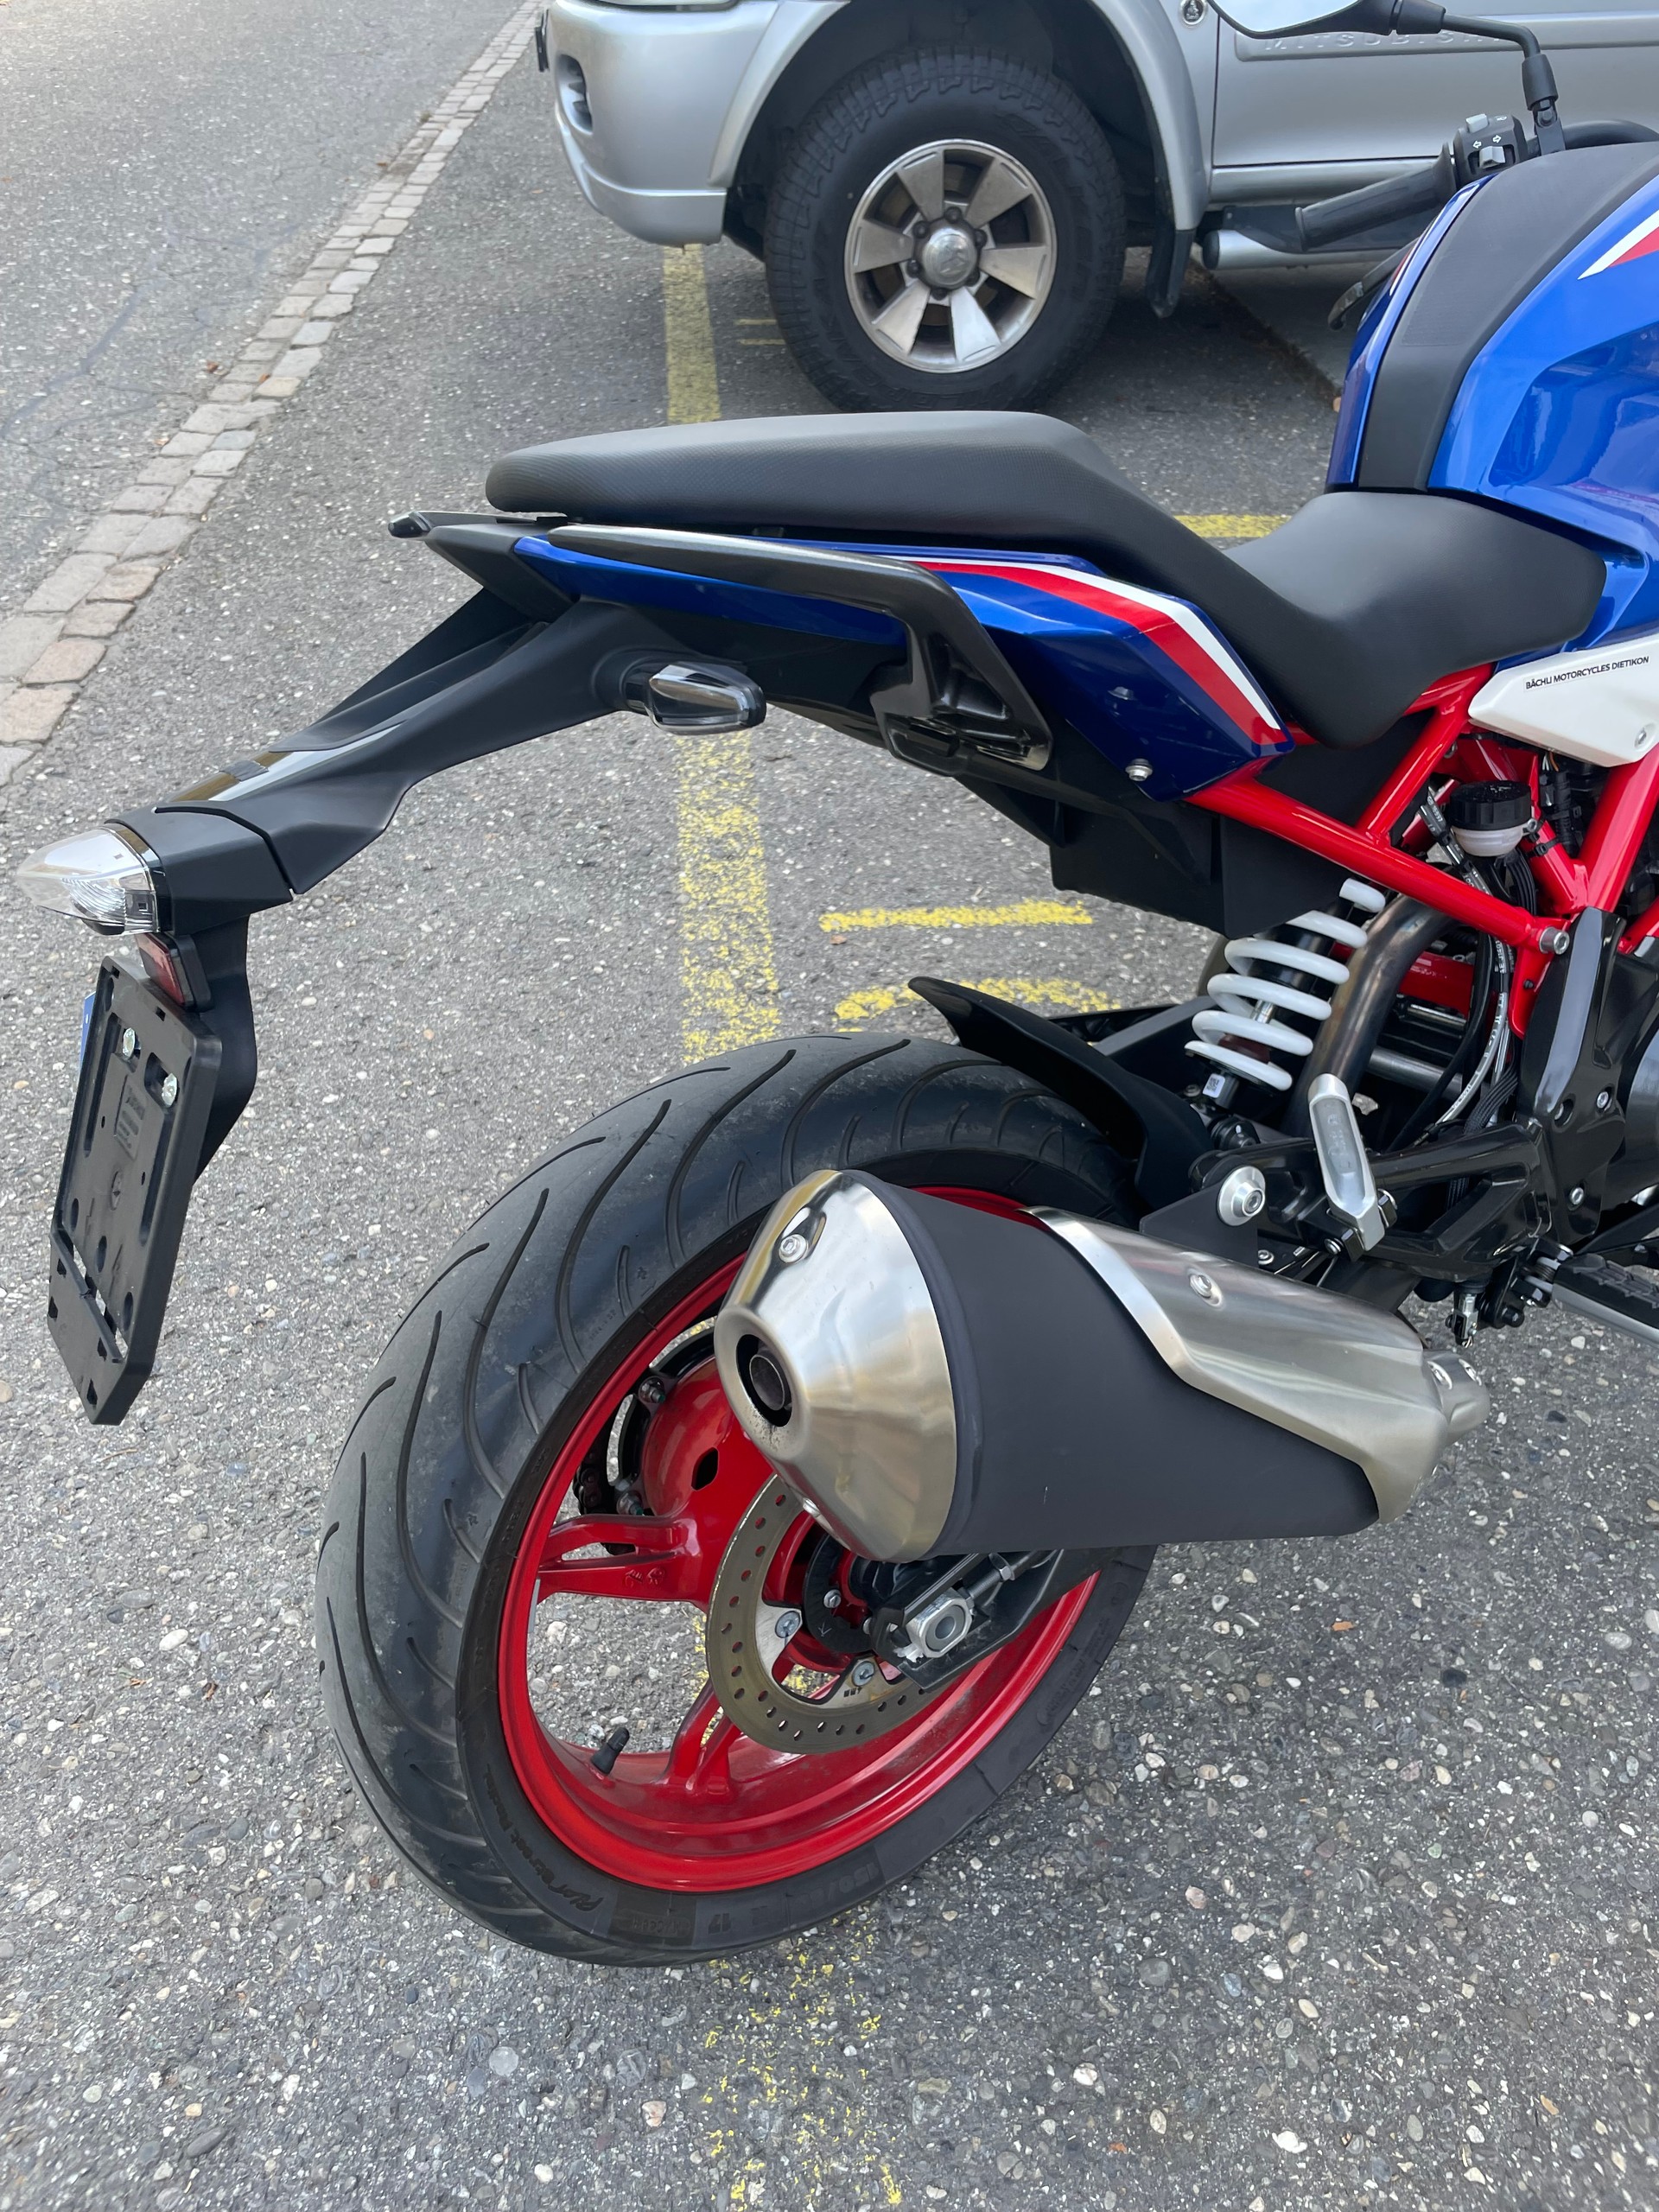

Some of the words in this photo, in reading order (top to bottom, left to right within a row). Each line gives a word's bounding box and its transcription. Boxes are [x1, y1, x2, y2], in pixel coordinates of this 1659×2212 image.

[1264, 30, 1499, 50] MITSUBISH
[1525, 675, 1552, 690] BÄCHLI
[1553, 663, 1611, 683] MOTORCYCLES
[1611, 656, 1649, 671] DIETIKON
